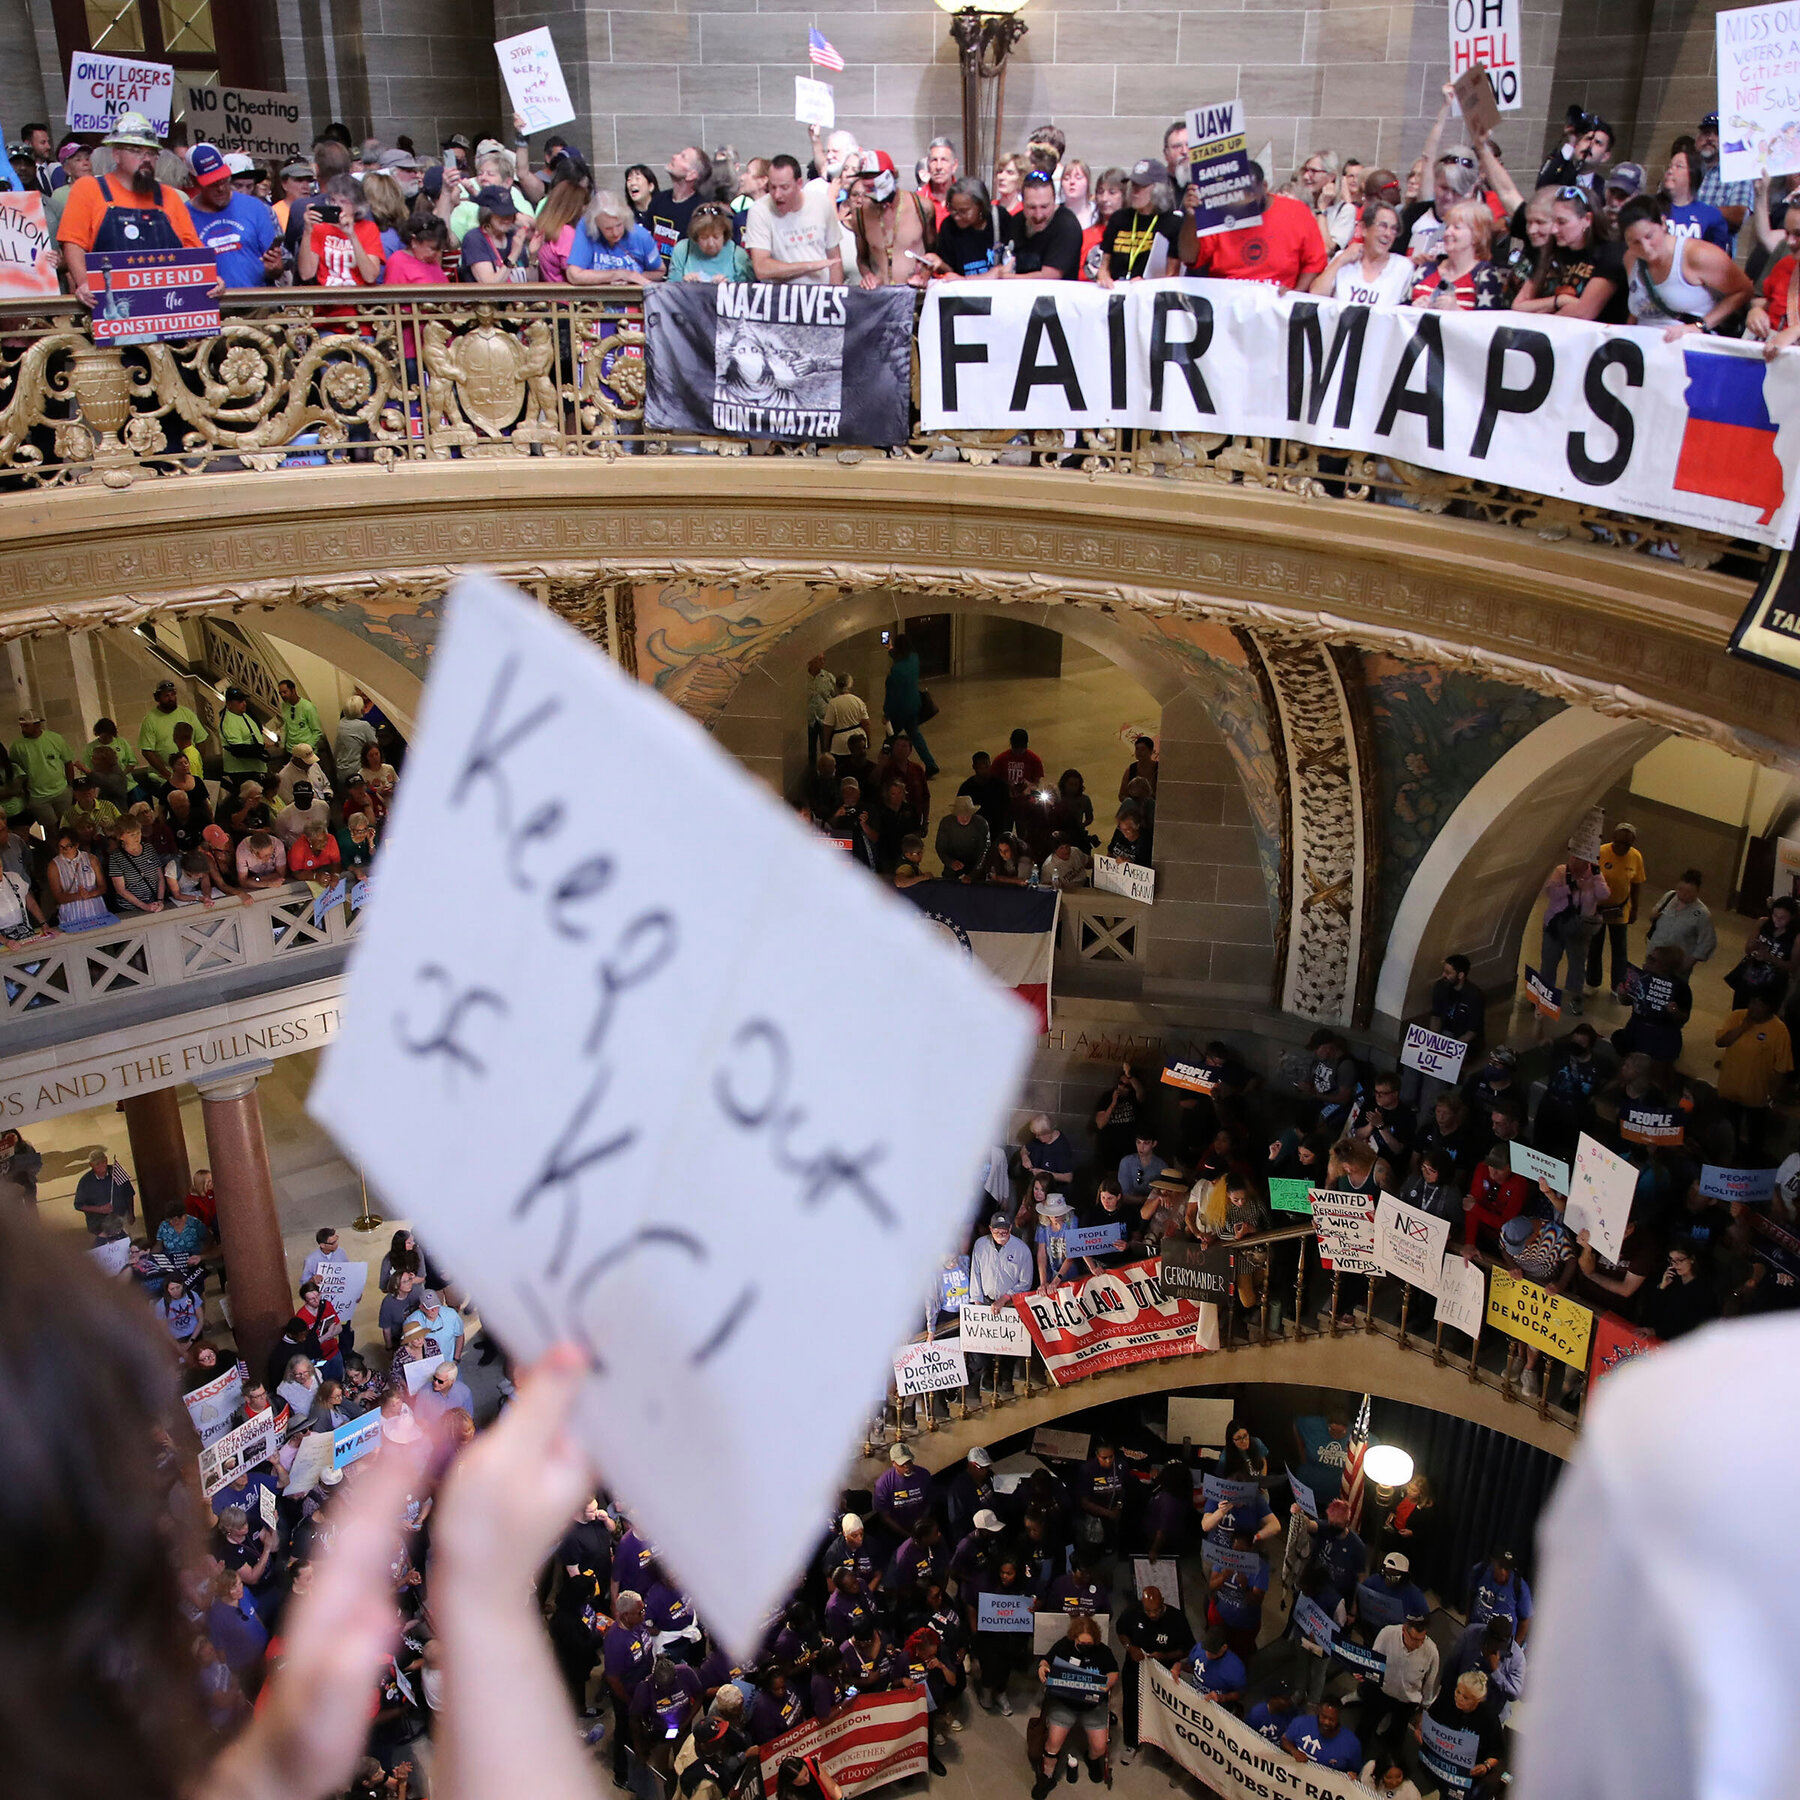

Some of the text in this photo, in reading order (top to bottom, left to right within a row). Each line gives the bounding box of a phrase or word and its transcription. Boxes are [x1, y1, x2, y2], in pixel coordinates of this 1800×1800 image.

[1455, 0, 1503, 32] OH
[1454, 33, 1515, 73] HELL
[1734, 43, 1783, 65] VOTERS
[77, 63, 171, 86] ONLY LOSERS
[91, 82, 152, 101] CHEAT
[105, 100, 130, 116] NO
[189, 88, 299, 123] NO Cheating
[225, 115, 253, 134] NO
[1195, 105, 1233, 138] UAW
[1192, 137, 1242, 160] STAND UP
[1198, 161, 1239, 180] SAVING
[128, 269, 205, 287] DEFEND
[163, 291, 184, 309] the
[717, 283, 848, 325] NAZI LIVES
[1350, 286, 1379, 304] YOU
[97, 313, 219, 336] CONSTITUTION
[937, 293, 1644, 486] FAIR MAPS
[713, 402, 841, 437] DON'T MATTER
[450, 650, 680, 1058] Keep
[1122, 863, 1150, 883] AMERICA
[35, 1073, 106, 1111] AND
[112, 1054, 173, 1087] THE
[181, 1018, 309, 1070] FULLNESS
[1173, 1062, 1212, 1080] PEOPLE
[1418, 1054, 1442, 1070] LOL
[712, 1014, 900, 1230] Out
[1629, 1110, 1672, 1126] PEOPLE
[1527, 1152, 1557, 1169] RESPECT
[1591, 1148, 1617, 1171] SAVE
[1720, 1173, 1759, 1182] PEOPLE
[1313, 1192, 1367, 1207] WANTED
[1328, 1217, 1359, 1230] WHO
[1078, 1230, 1108, 1239] PEOPLE
[1070, 1243, 1114, 1253] POLITICIAN
[320, 1263, 342, 1275] the
[943, 1270, 966, 1284] FIRE
[1164, 1265, 1225, 1293] GERRYMANDER
[319, 1283, 345, 1293] lace
[323, 1276, 346, 1284] ame
[1521, 1285, 1559, 1311] SAVE
[1031, 1286, 1125, 1331] RACIAL
[1441, 1300, 1471, 1325] HELL
[1517, 1300, 1551, 1322] OUR
[175, 1316, 191, 1328] NO
[966, 1324, 998, 1338] WAKE
[1077, 1336, 1092, 1347] WE
[1123, 1322, 1146, 1333] FIGHT
[1147, 1317, 1170, 1330] EACH
[1491, 1301, 1574, 1355] DEMOCRACY
[1075, 1332, 1161, 1360] BLACK WHITE
[922, 1351, 941, 1365] NO
[1060, 1367, 1075, 1378] WE
[1077, 1358, 1102, 1373] FIGHT
[1103, 1351, 1129, 1364] WAGE
[904, 1359, 956, 1379] DICTATOR
[185, 1369, 239, 1407] MISSING
[904, 1373, 962, 1395] MISSOURI
[217, 1416, 260, 1448] ONE-PARTY
[335, 1428, 362, 1447] MISSOURI
[336, 1427, 379, 1457] MY ASS
[206, 1451, 267, 1497] DOWN WITH THEM
[1216, 1481, 1245, 1491] PEOPLE
[991, 1600, 1020, 1608] PEOPLE
[981, 1616, 1030, 1625] POLITICIANS
[1307, 1604, 1329, 1630] PEOPLE
[1309, 1616, 1323, 1630] NOT
[1335, 1644, 1380, 1670] DEMOCRACY
[1342, 1640, 1372, 1658] DEFEND
[1052, 1678, 1100, 1690] DEMOCRACY
[1061, 1672, 1093, 1682] DEFEND
[775, 1714, 871, 1767] ECONOMIC FREEDOM
[1151, 1678, 1301, 1789] UNITED AGAINST
[1431, 1726, 1463, 1746] PEOPLE
[1423, 1733, 1472, 1765] POLITICIANS
[1435, 1737, 1455, 1751] NOT
[839, 1746, 886, 1765] TOGETHER
[1175, 1723, 1269, 1799] GOOD JOBS
[847, 1767, 862, 1779] DO
